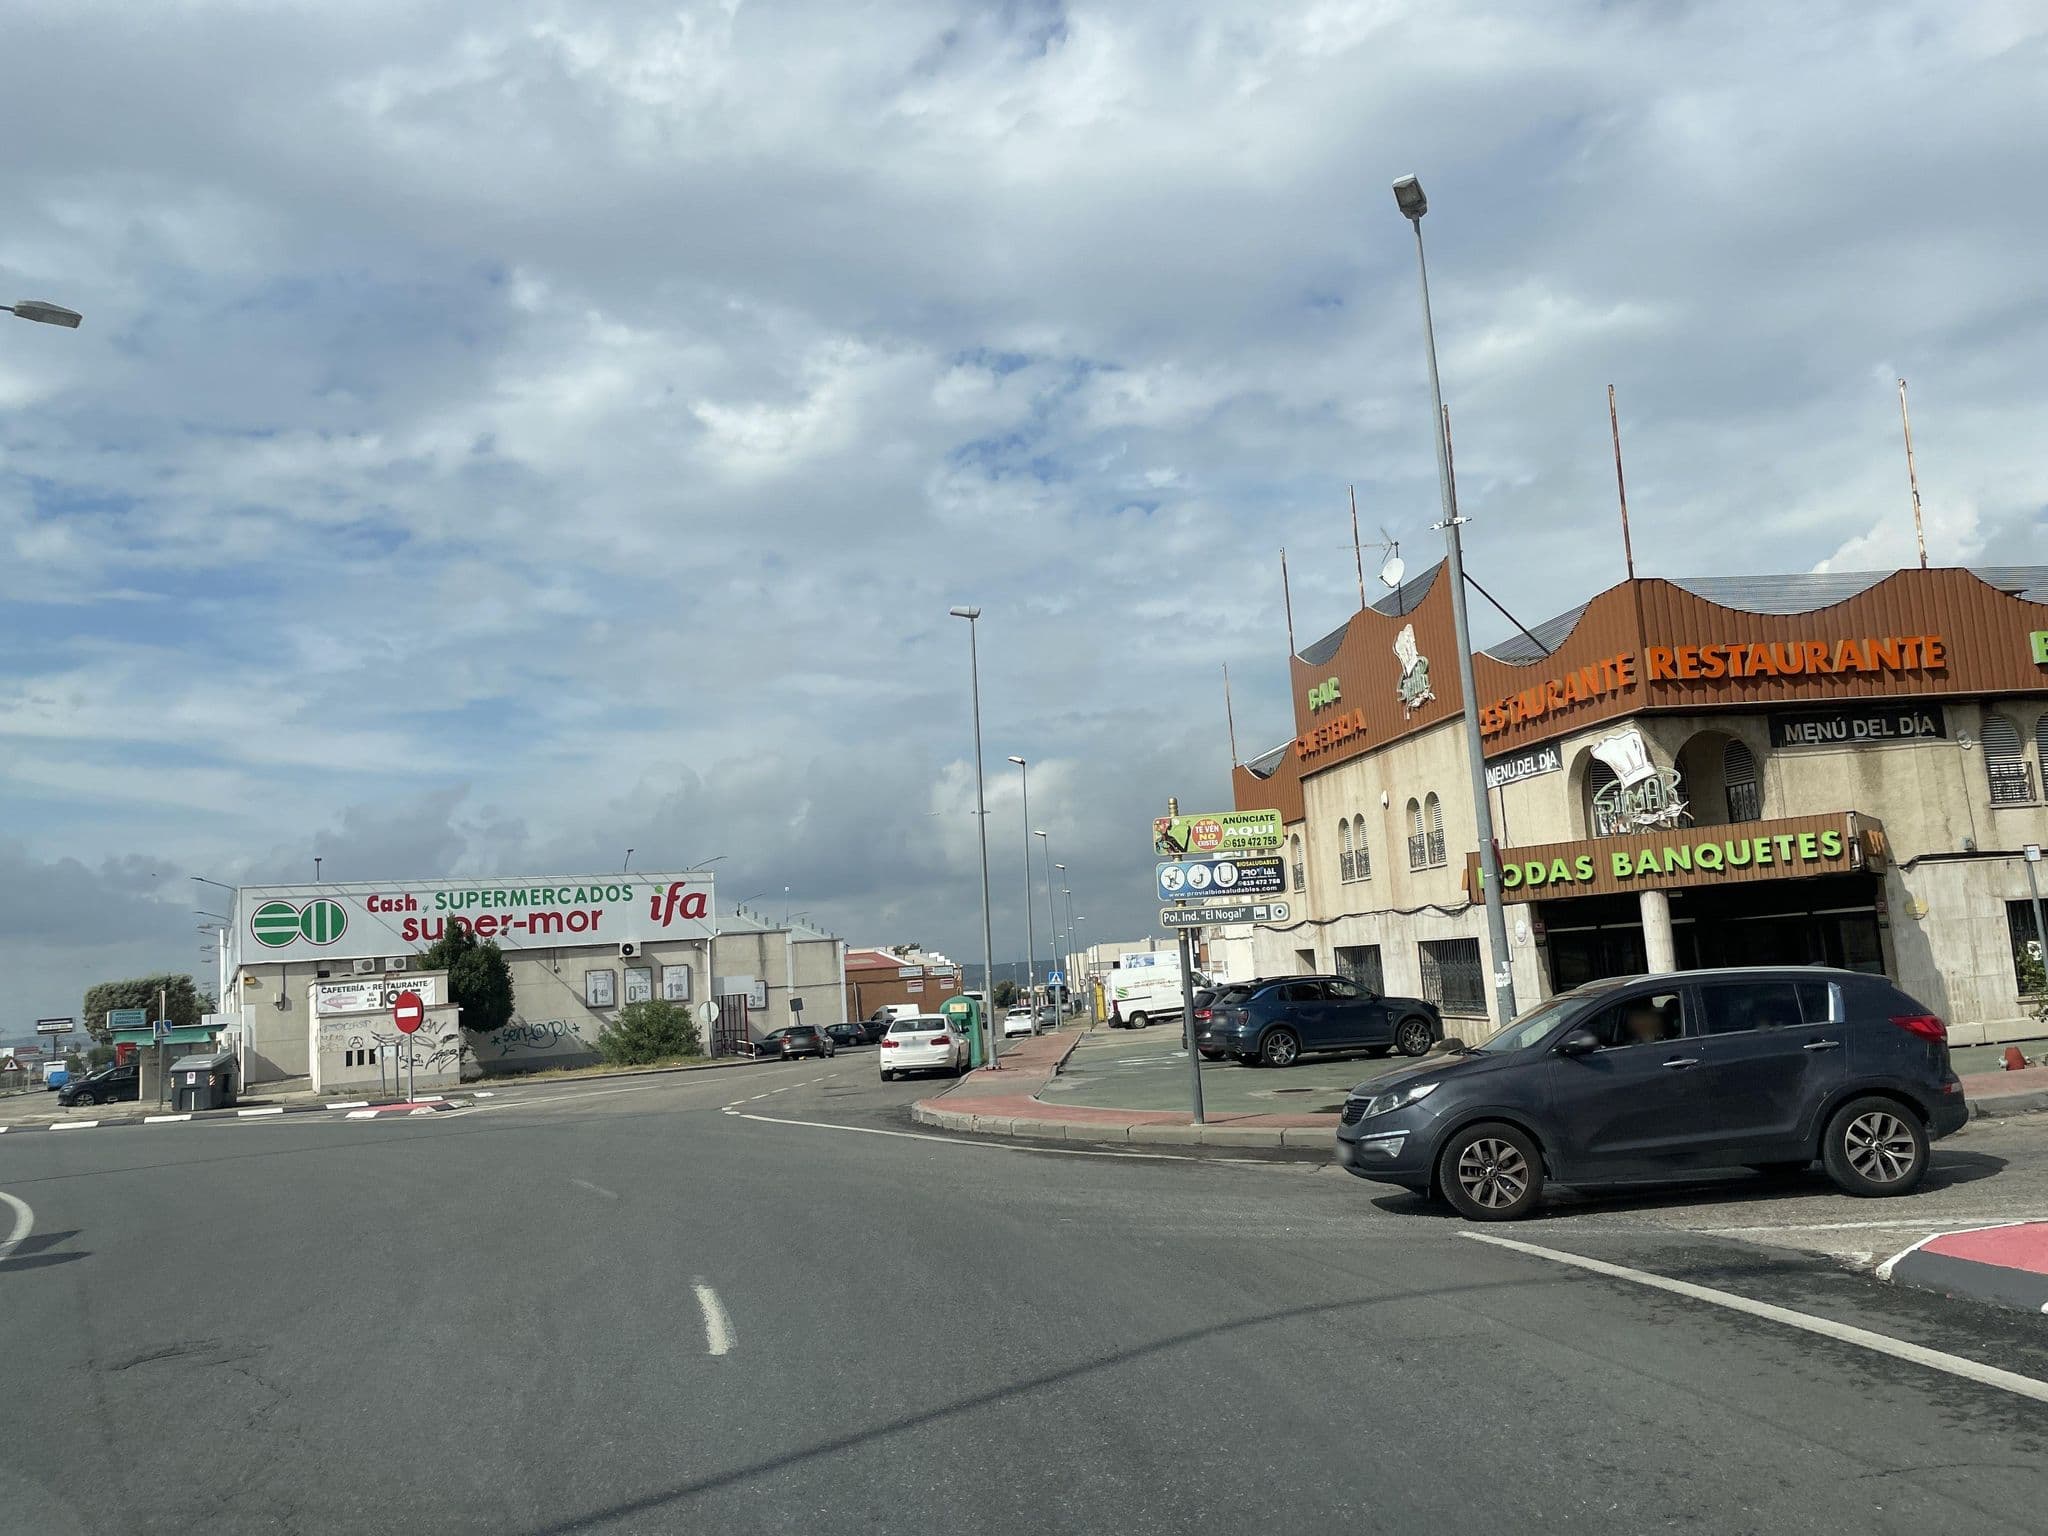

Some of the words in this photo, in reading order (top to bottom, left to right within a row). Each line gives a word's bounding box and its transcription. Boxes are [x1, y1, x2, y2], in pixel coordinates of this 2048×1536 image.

[1644, 636, 1947, 681] RESTAURANTE
[1308, 677, 1341, 711] BAR
[1479, 651, 1637, 736] ESTAURANTE
[1784, 716, 1847, 744] MENÚ
[1852, 718, 1894, 738] DEL
[1900, 711, 1937, 735] DÍA
[1485, 759, 1517, 787] MENÚ
[1517, 756, 1537, 776] DEL
[1538, 748, 1558, 771] DÍA
[1195, 825, 1205, 833] TE
[1223, 814, 1276, 825] ANÚNCIATE
[1232, 838, 1246, 848] 619
[1247, 837, 1261, 847] 472
[1263, 836, 1277, 846] 758
[1477, 854, 1594, 889] ODAS
[1611, 830, 1843, 877] BANQUETES
[367, 893, 418, 913] Cash
[435, 884, 634, 911] SUPERMERCADOS
[650, 881, 708, 928] ifa
[1163, 912, 1181, 923] Pol.
[1182, 911, 1200, 922] Ind.
[321, 983, 365, 994] CAFETERÍA
[372, 980, 428, 990] RETAURANTE
[378, 989, 422, 1007] JO
